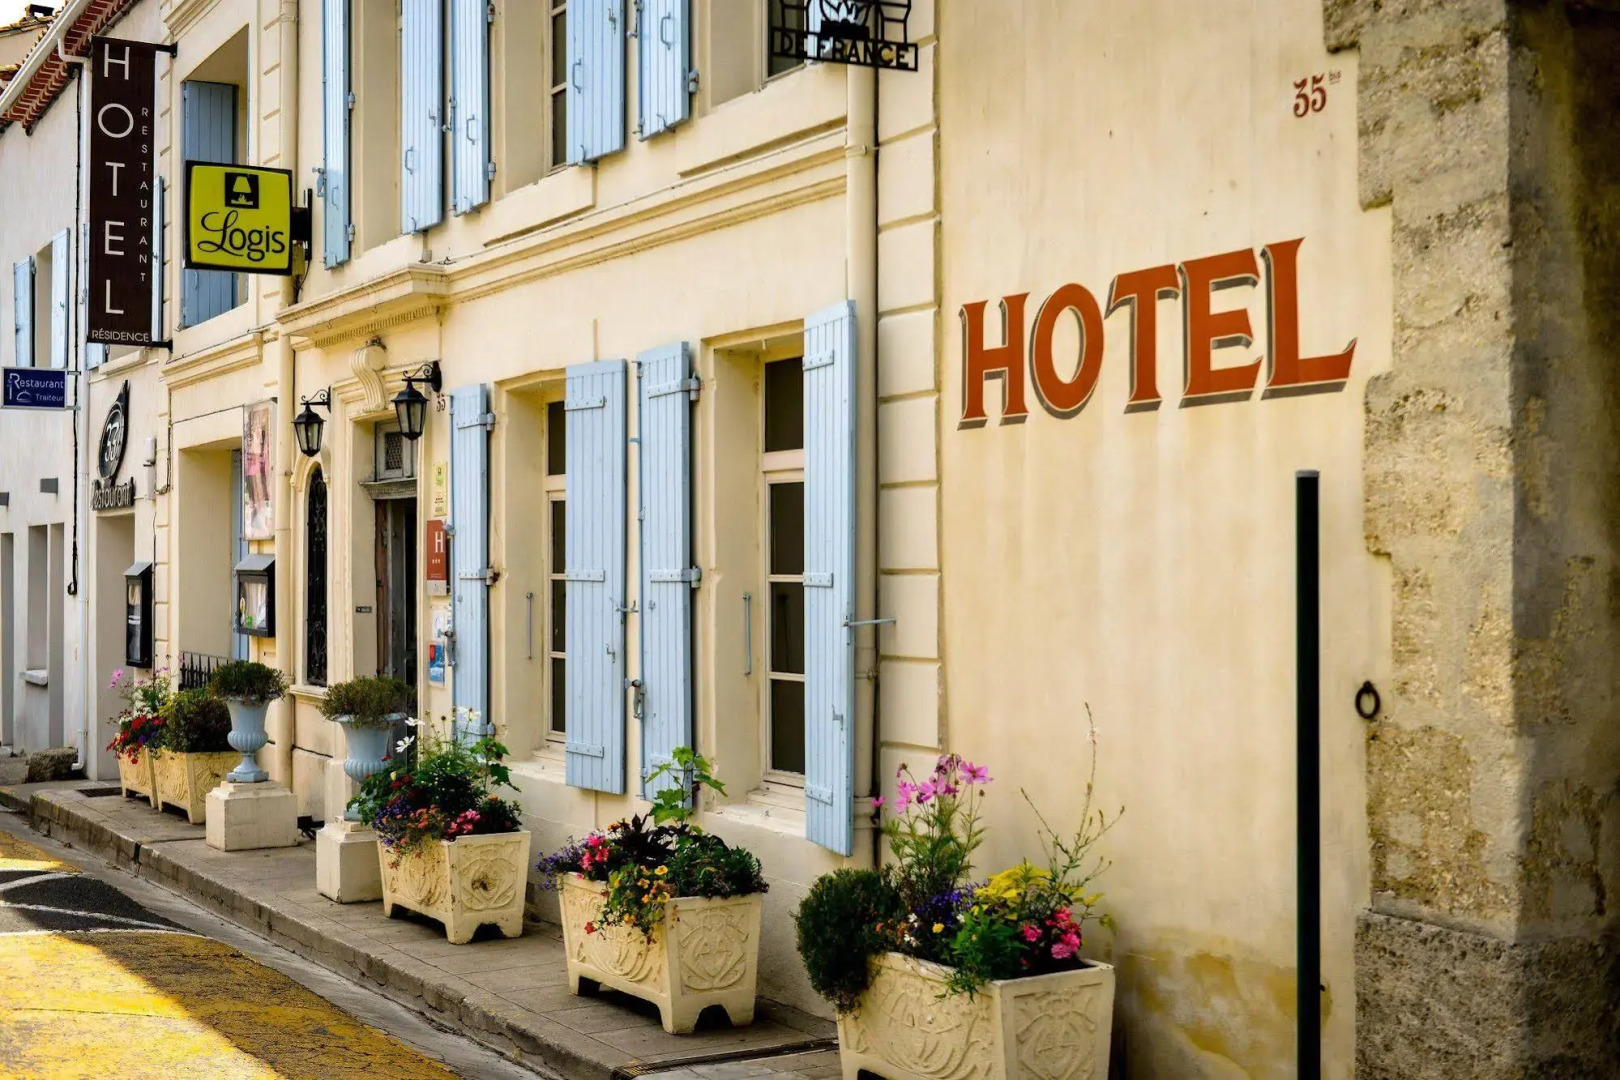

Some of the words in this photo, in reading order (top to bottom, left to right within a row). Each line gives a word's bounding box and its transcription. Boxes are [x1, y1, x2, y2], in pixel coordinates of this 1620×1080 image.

[816, 35, 909, 68] FRANCE
[1293, 73, 1327, 118] 35
[97, 43, 134, 315] HOTEL
[139, 107, 149, 282] RESTAURANT
[197, 209, 286, 262] Logis
[91, 328, 150, 343] RÉSIDENCE
[957, 237, 1358, 431] HOTEL
[8, 373, 65, 390] Restaurant
[35, 393, 65, 402] Traiteur
[434, 531, 445, 553] H
